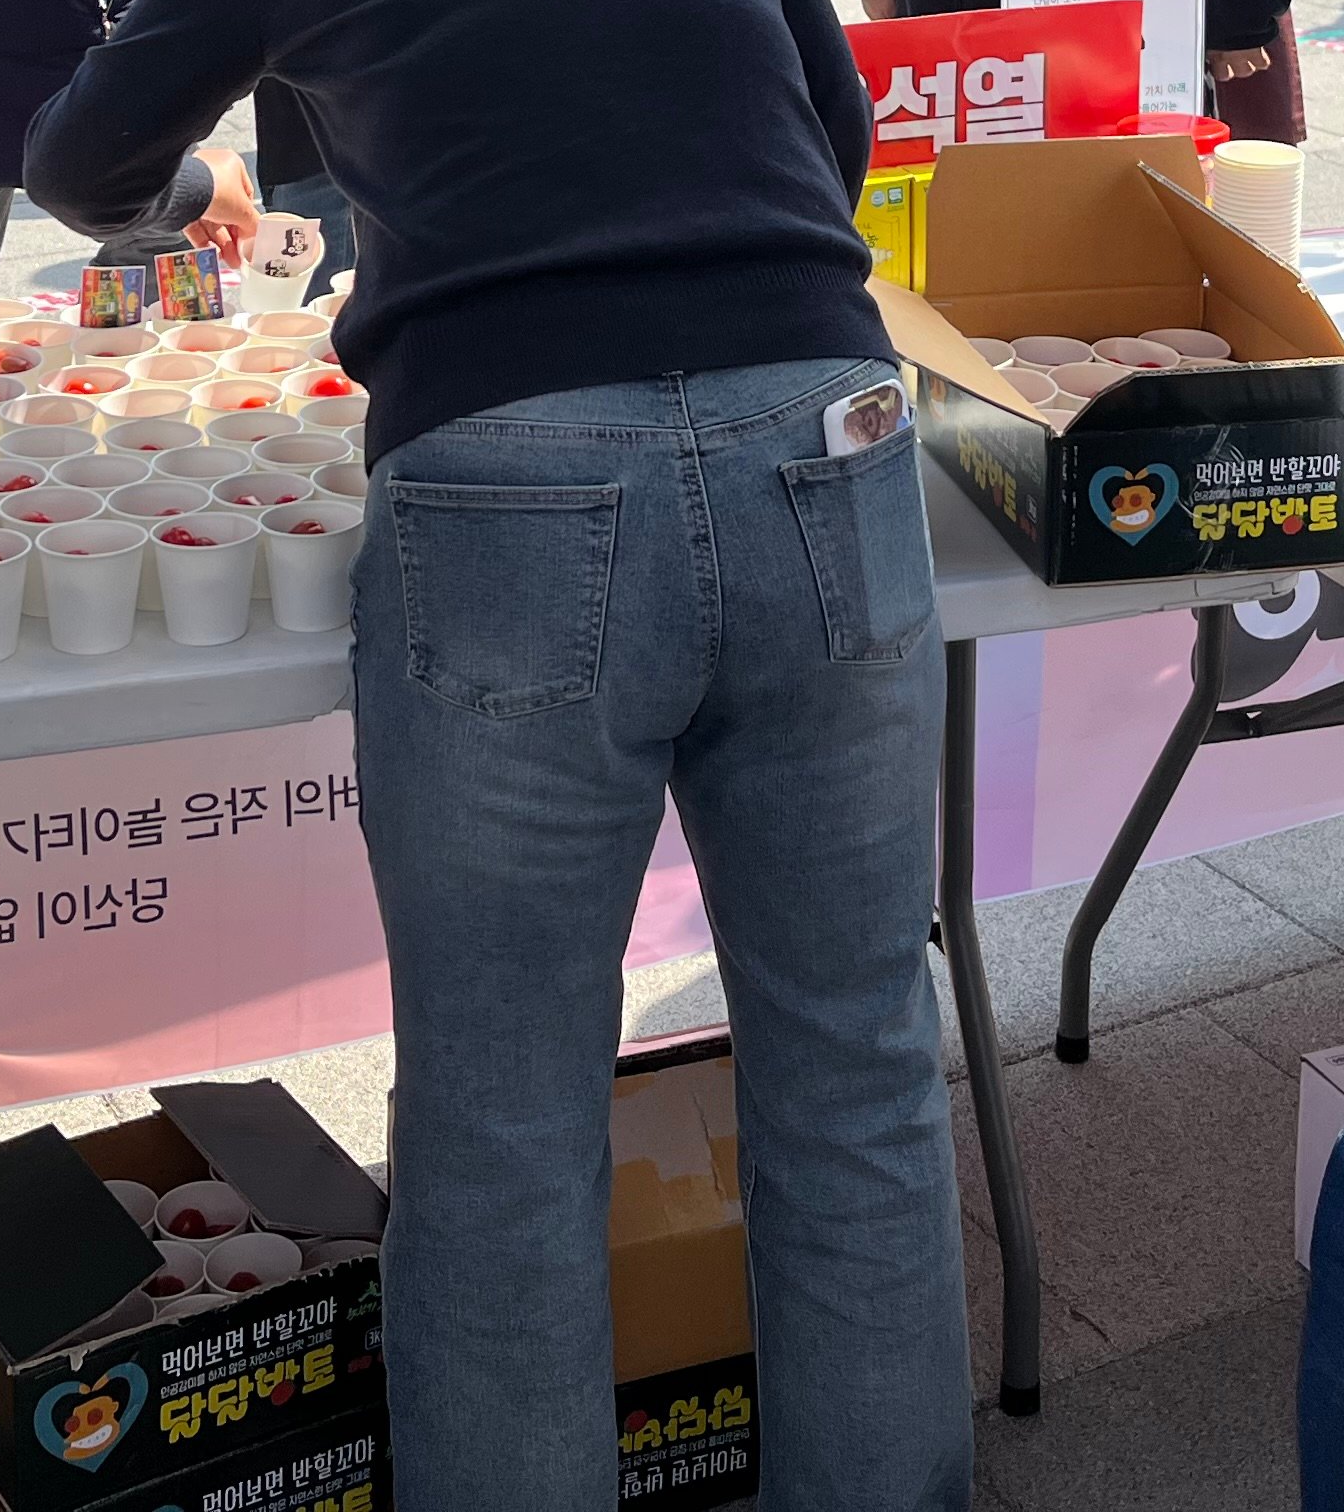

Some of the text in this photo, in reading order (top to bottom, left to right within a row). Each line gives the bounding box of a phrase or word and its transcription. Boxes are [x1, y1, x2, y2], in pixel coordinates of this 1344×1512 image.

[857, 52, 1046, 155] 석열
[1195, 453, 1342, 486] 먹어보면 반할꼬야
[161, 1326, 245, 1378] 먹어보면
[252, 1295, 338, 1349] 반할꼬야
[203, 1467, 285, 1512] 먹어보면
[292, 1435, 376, 1488] 반할꼬야
[671, 1445, 748, 1487] 먹어보면
